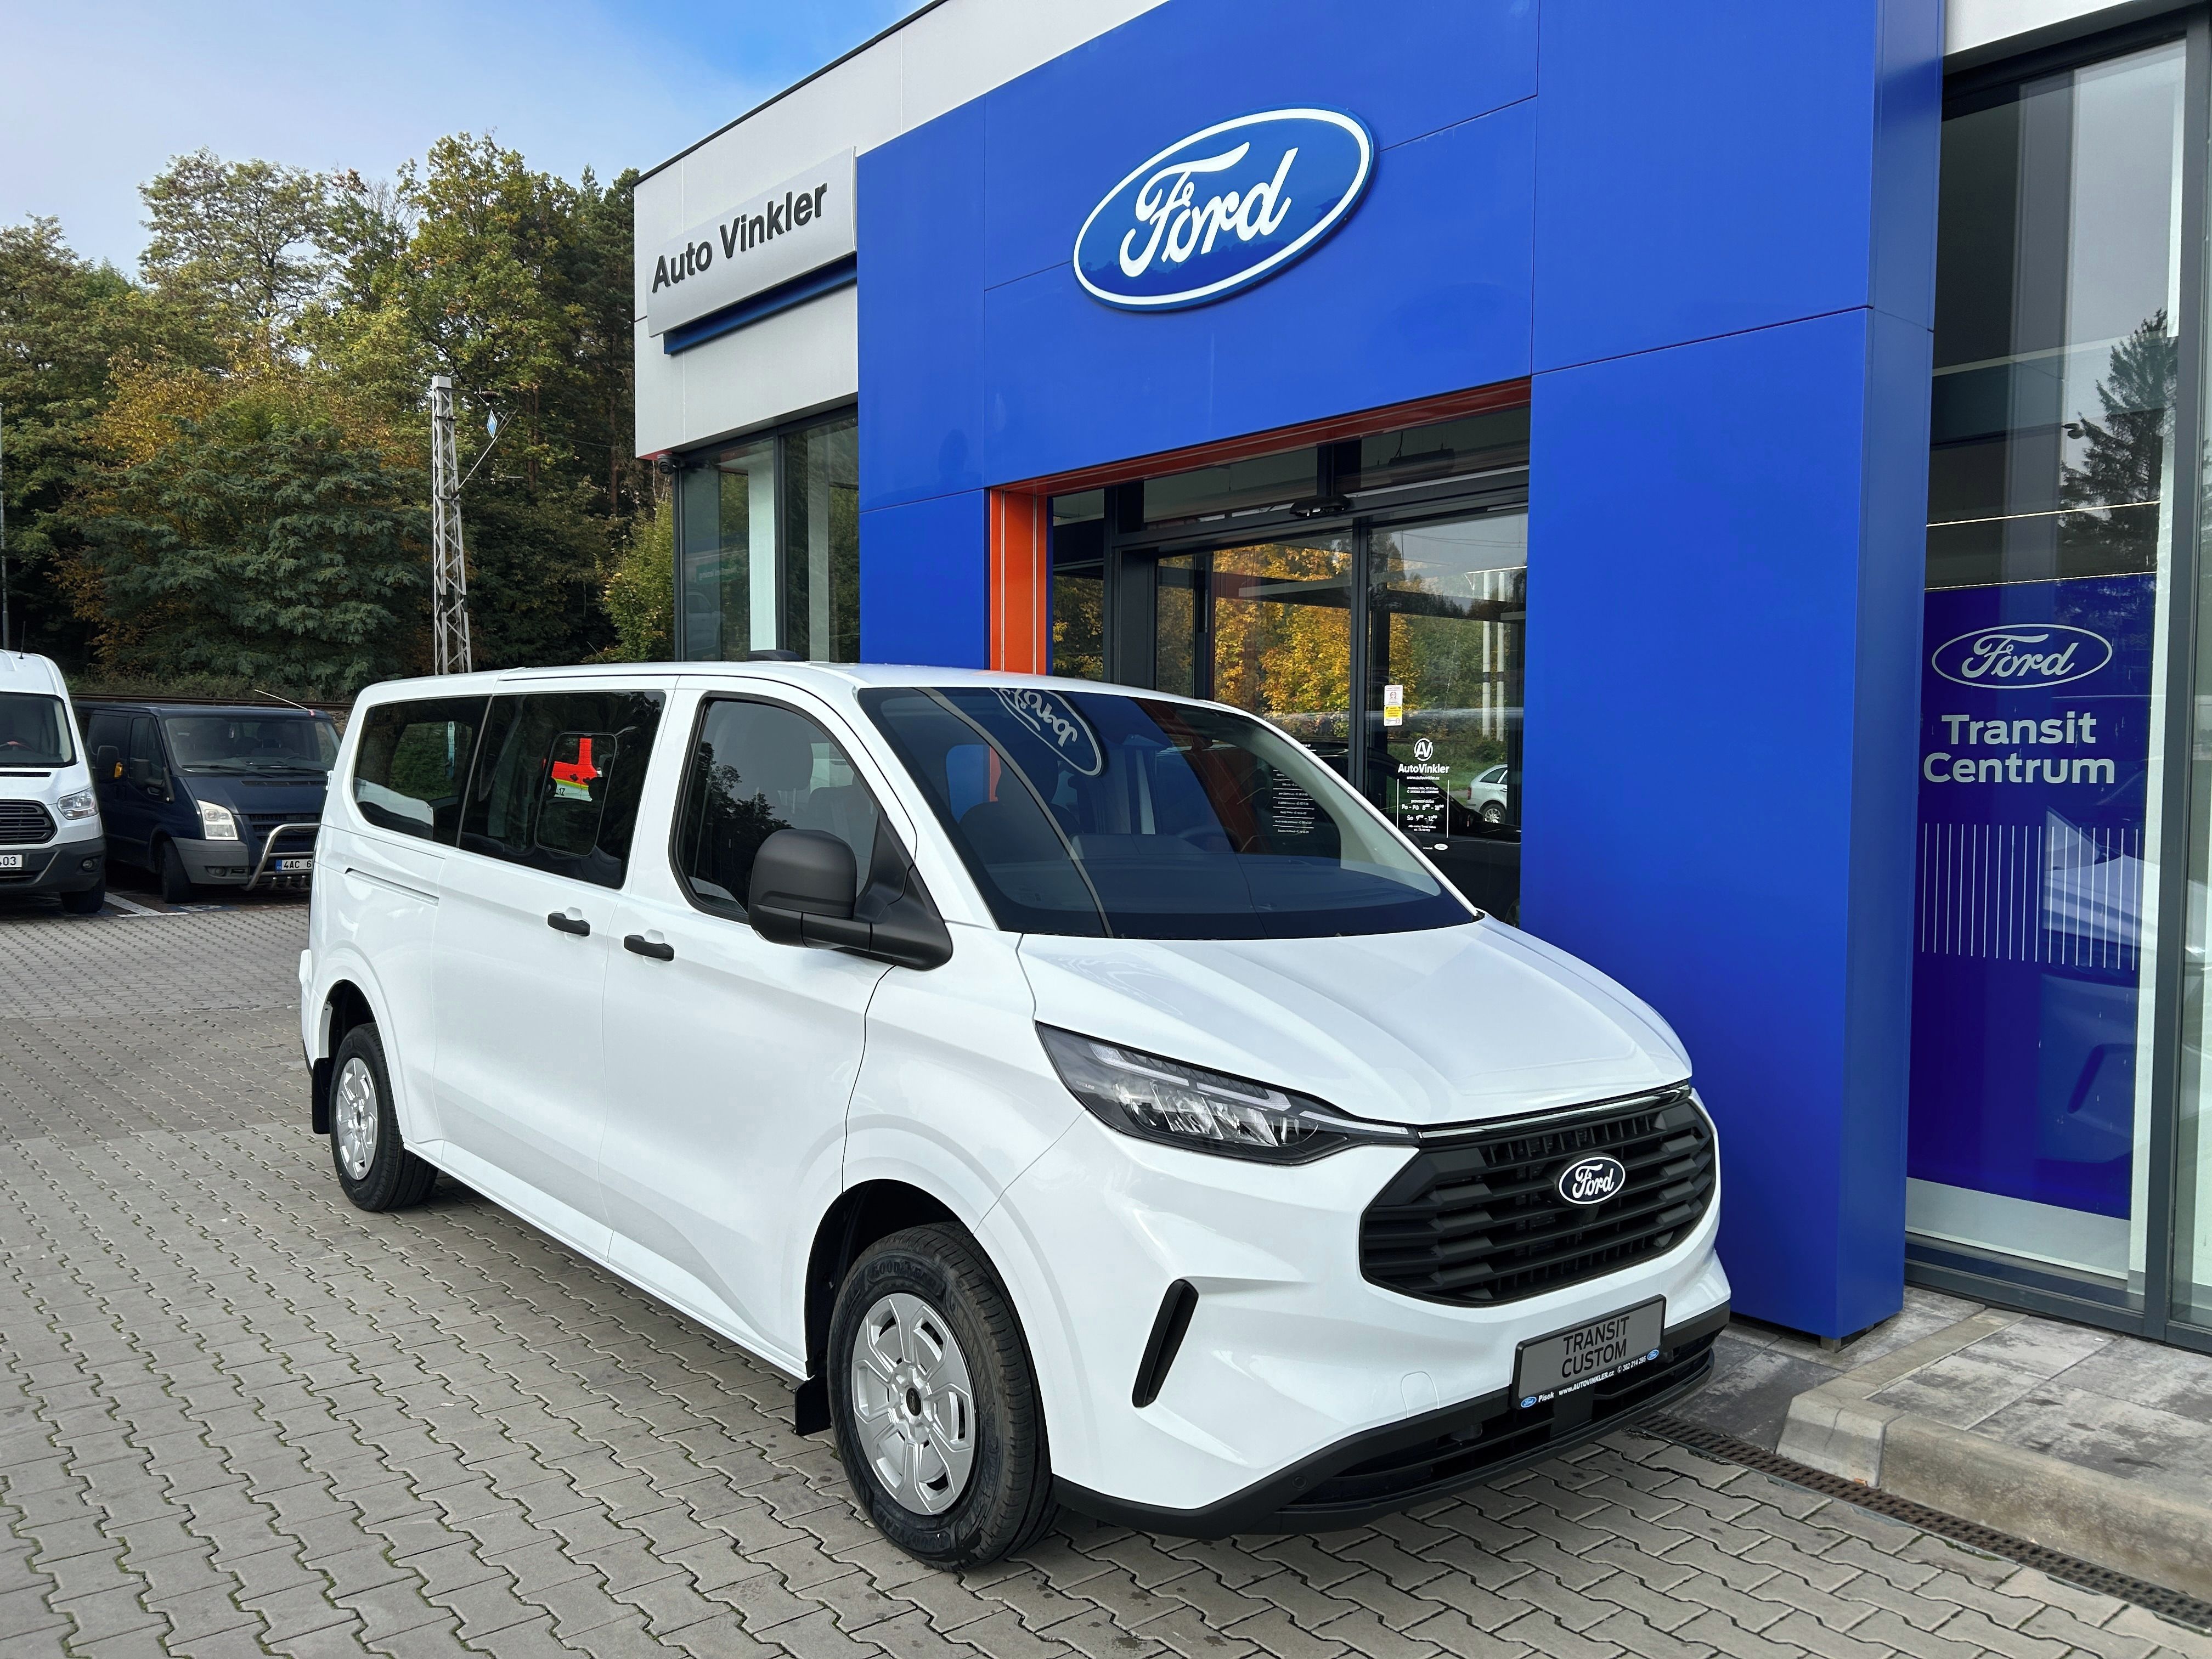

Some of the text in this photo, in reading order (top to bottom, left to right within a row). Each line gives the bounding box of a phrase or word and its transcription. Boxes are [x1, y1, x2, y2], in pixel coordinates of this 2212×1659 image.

[1119, 141, 1299, 277] Ford
[652, 183, 827, 293] Auto Vinkler
[1961, 634, 2079, 678] Ford
[1942, 711, 2097, 744] Transit
[1397, 763, 1450, 774] AutoVinkler
[1923, 752, 2115, 783] Centrum
[0, 856, 16, 866] 03
[284, 860, 300, 869] 4AC
[1572, 1163, 1615, 1199] Ford
[1563, 1316, 1629, 1355] TRANSIT
[1562, 1339, 1627, 1378] CUSTOM
